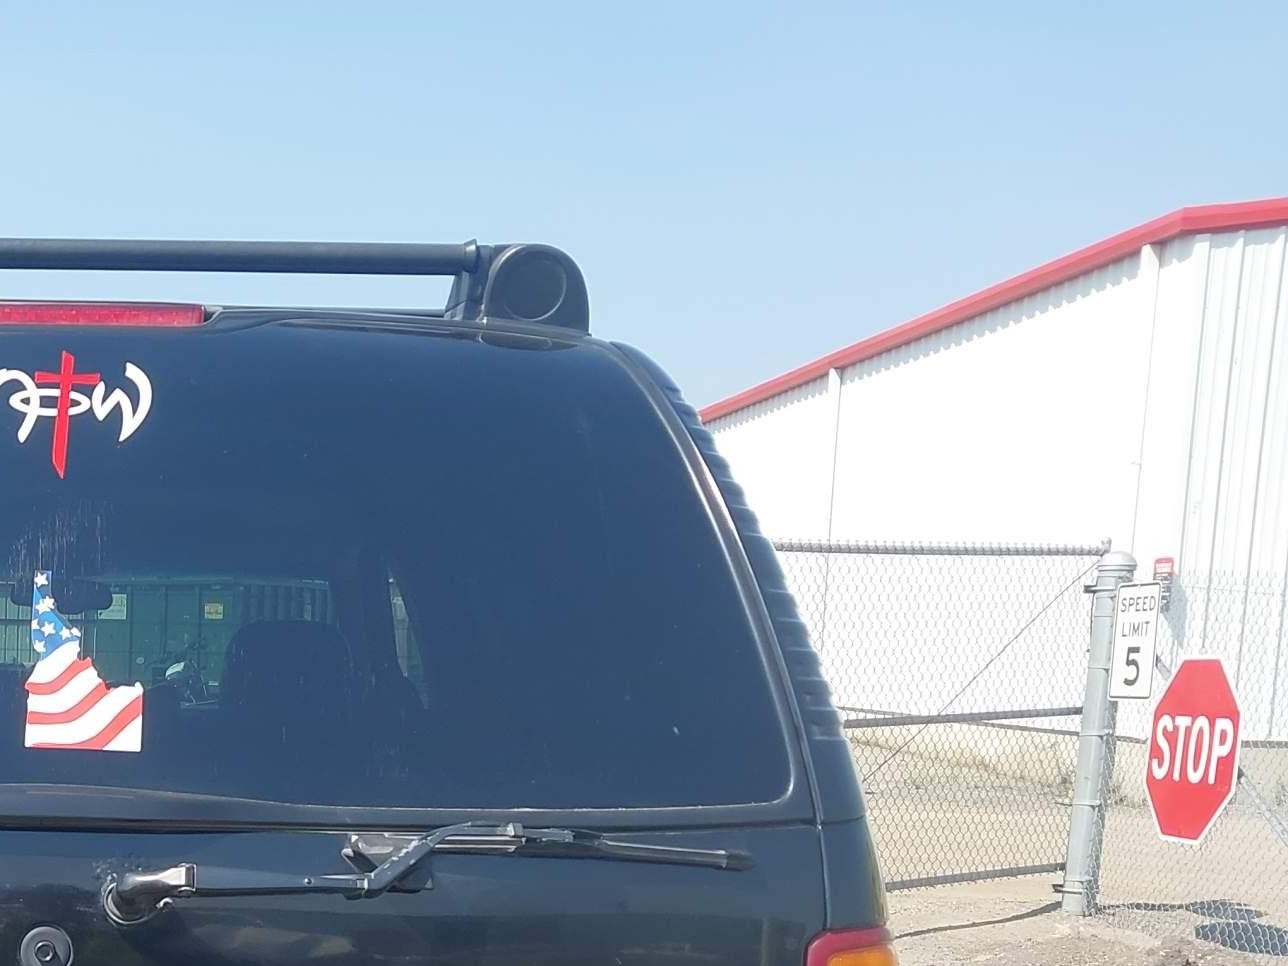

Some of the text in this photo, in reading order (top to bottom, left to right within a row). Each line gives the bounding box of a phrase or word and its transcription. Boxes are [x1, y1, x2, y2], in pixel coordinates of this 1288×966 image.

[1120, 595, 1157, 613] SPEED
[1121, 620, 1150, 638] LIMIT
[1123, 646, 1141, 686] 5
[1151, 714, 1234, 785] STOP
